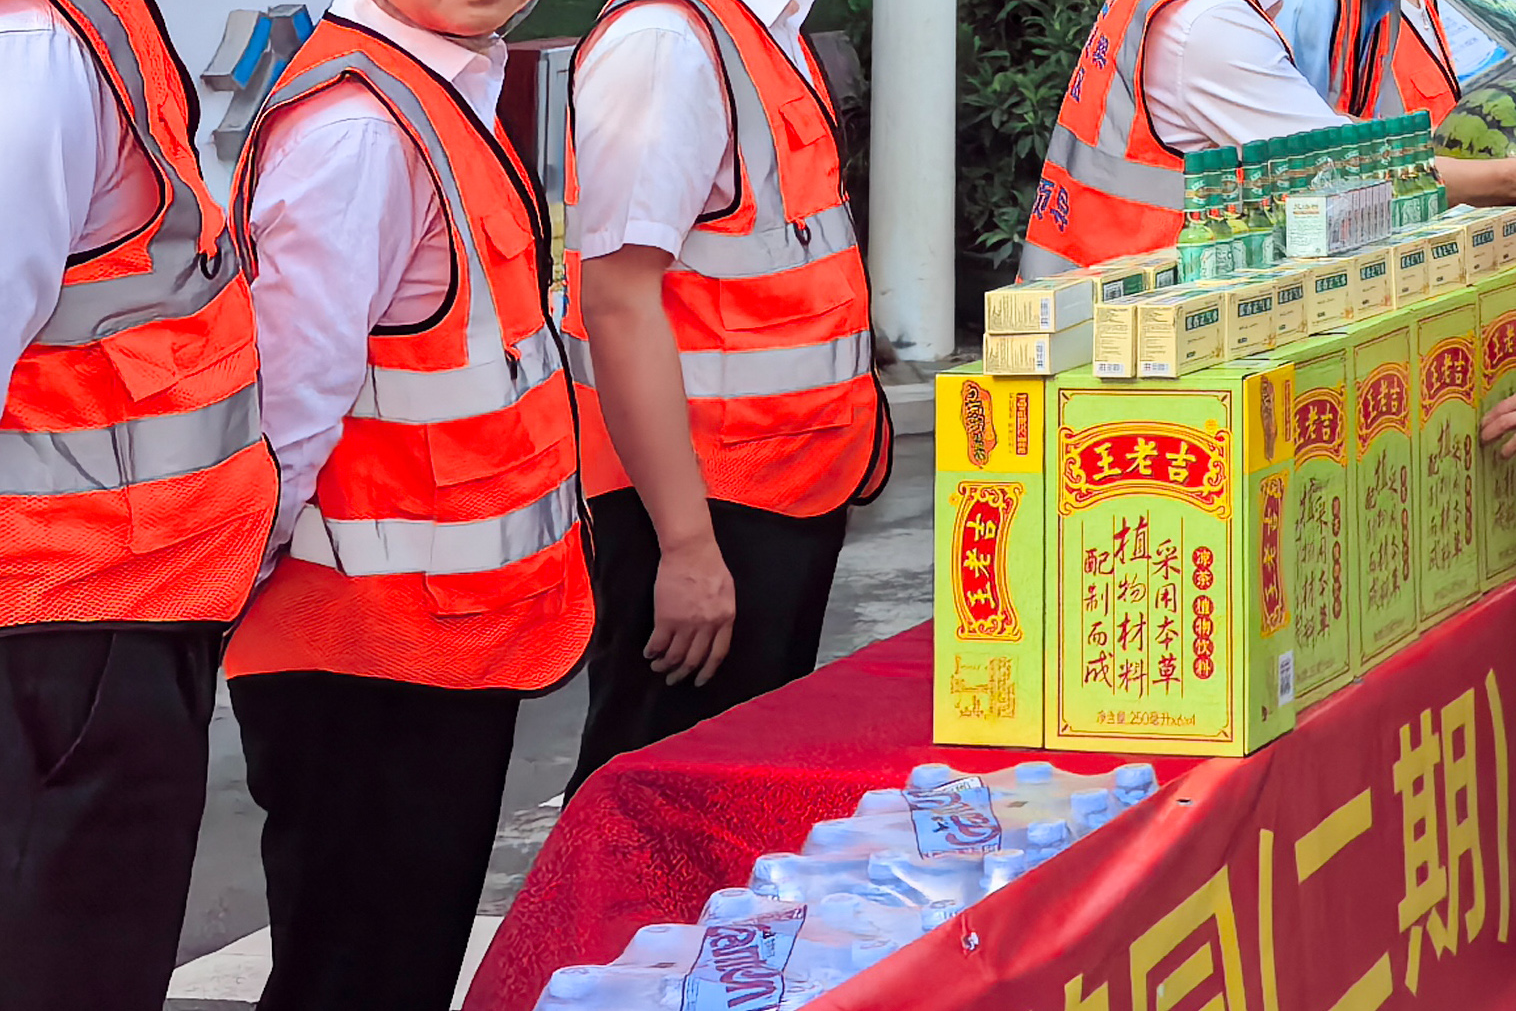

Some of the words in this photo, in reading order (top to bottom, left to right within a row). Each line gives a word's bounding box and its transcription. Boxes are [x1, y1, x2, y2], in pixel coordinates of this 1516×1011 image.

[1092, 437, 1197, 483] 王老吉
[963, 513, 998, 609] 王老吉
[1083, 547, 1115, 688] 配制而成
[1113, 515, 1152, 700] 植物材料
[1152, 538, 1181, 696] 采用本草
[1194, 549, 1213, 588] 凉茶
